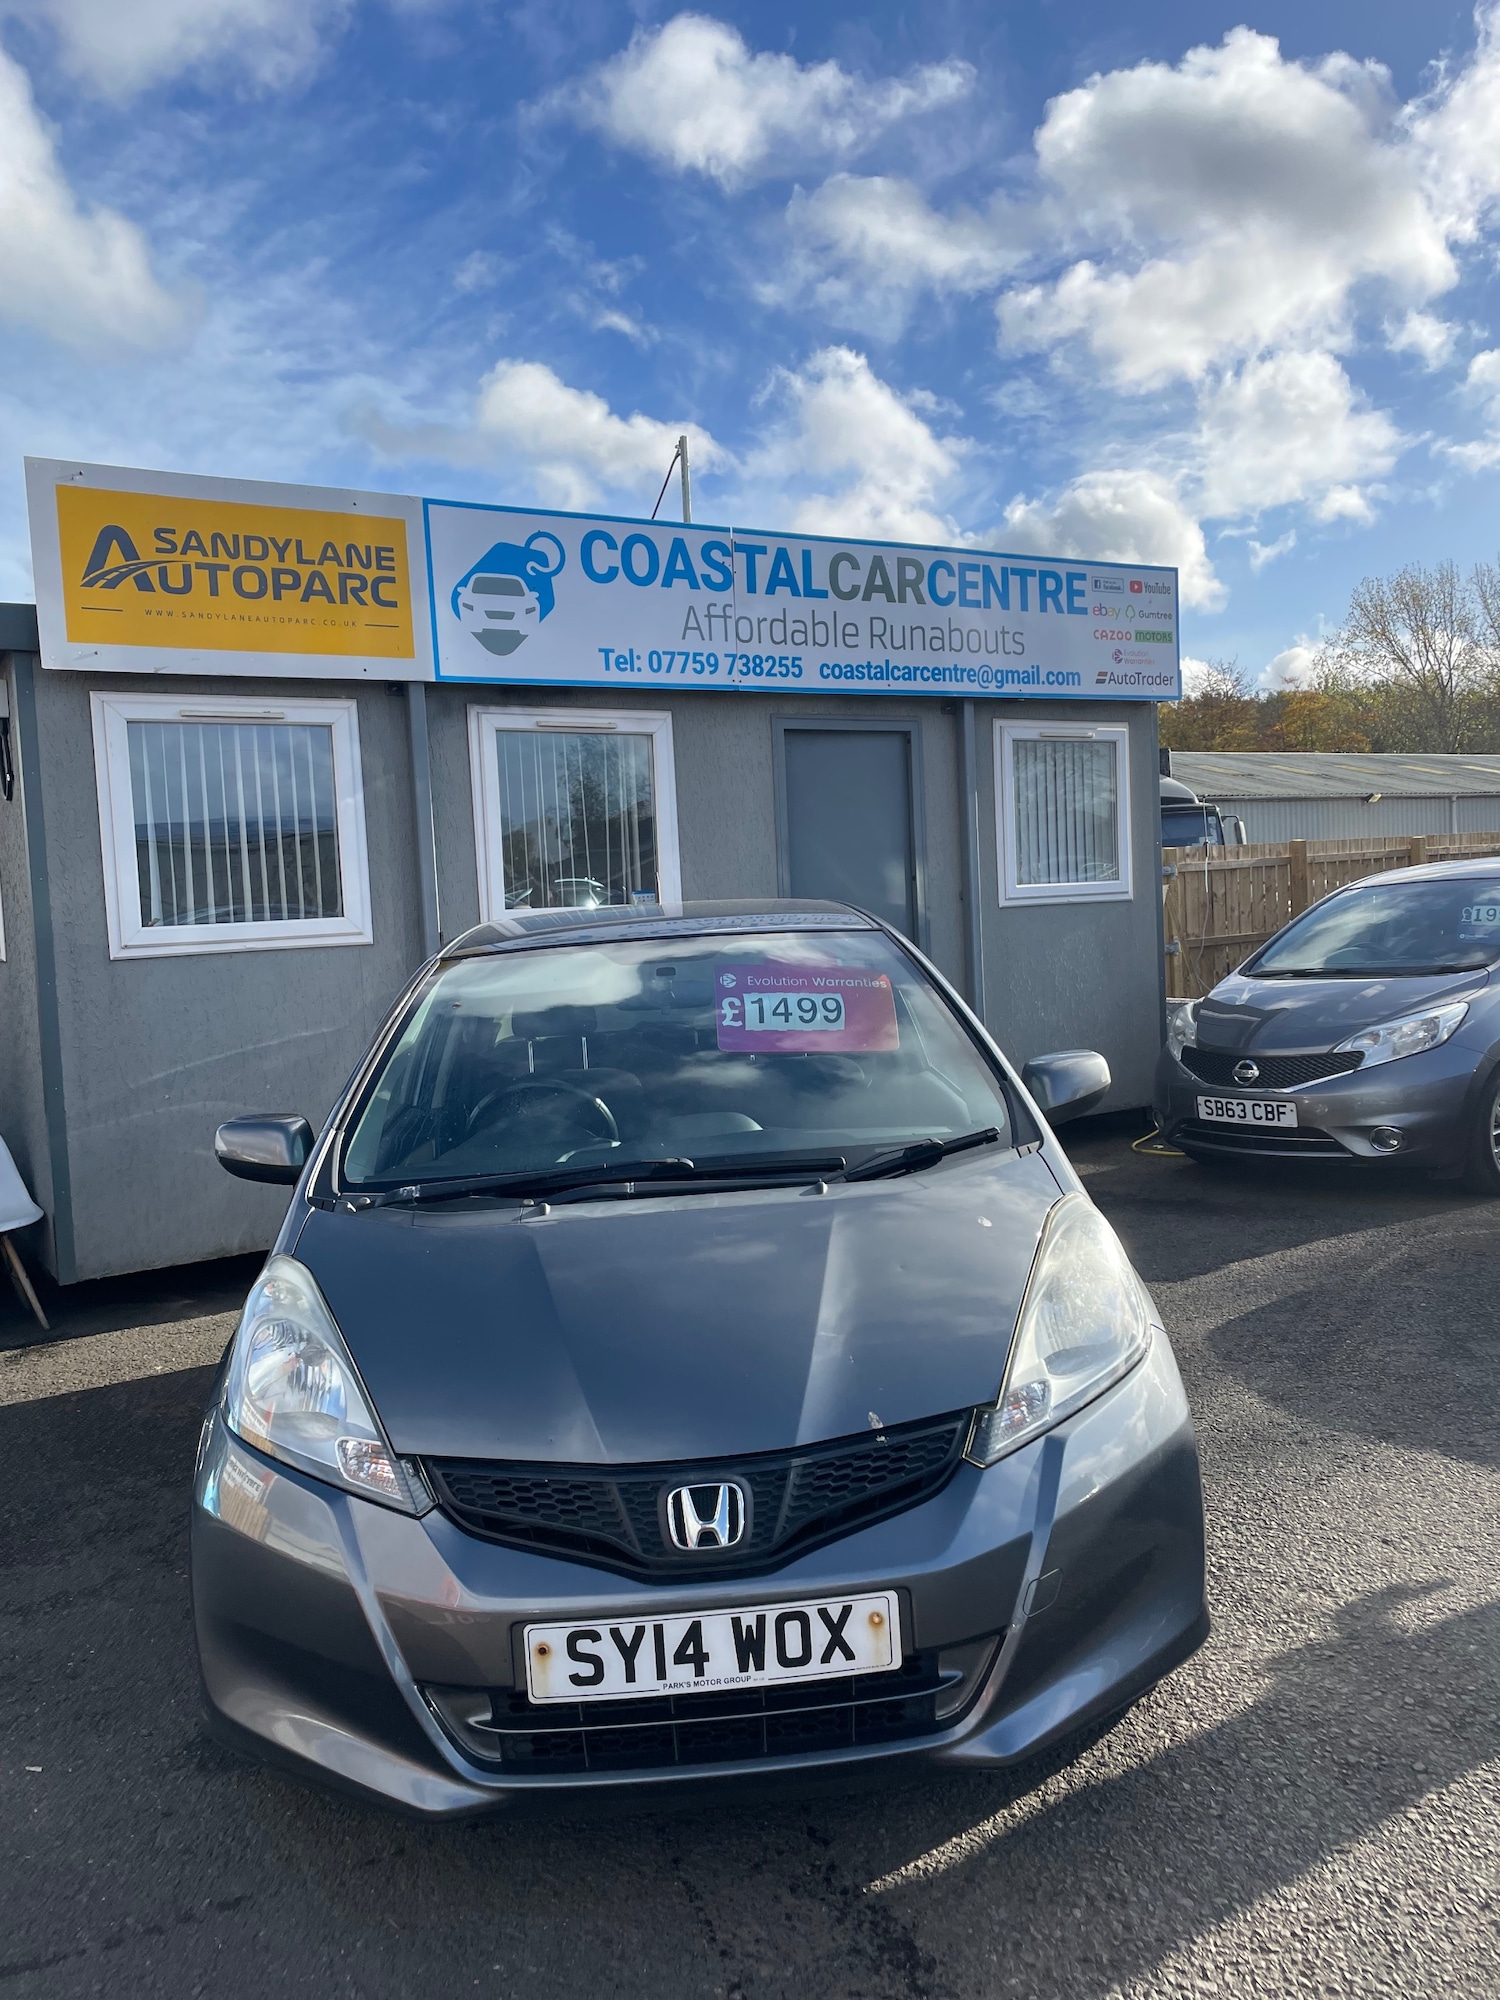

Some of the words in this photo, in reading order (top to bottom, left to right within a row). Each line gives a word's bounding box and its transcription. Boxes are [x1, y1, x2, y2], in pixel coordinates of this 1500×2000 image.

[154, 527, 395, 572] SANDYLANE
[80, 525, 398, 608] AUTOPARC
[580, 529, 1088, 615] COASTALCARCENTRE
[1144, 582, 1171, 595] YouTube
[144, 608, 357, 627] WWW.SANDYLANEAUTOPARC.CO.UK
[1093, 603, 1120, 620] ebay
[1138, 610, 1172, 620] Gumtree
[681, 603, 859, 648] Affordable
[869, 616, 1025, 656] Runabouts
[1093, 629, 1132, 641] CAZOO
[598, 648, 642, 673] Tel:
[648, 650, 719, 675] 07759
[724, 653, 803, 679] 738255
[819, 659, 1081, 689] coastalcarcentre@gmail.com
[1108, 671, 1174, 686] AutoTrader
[1461, 906, 1500, 922] £19
[747, 975, 808, 987] Evolution
[812, 976, 887, 989] Warranties
[721, 996, 842, 1027] £1499
[1204, 1099, 1247, 1119] SB63
[1252, 1103, 1287, 1121] CBF
[566, 1620, 710, 1687] SY14
[731, 1604, 856, 1673] WOX
[662, 1681, 692, 1690] PARK'S
[694, 1678, 722, 1687] MOTOR
[724, 1675, 752, 1685] GROUP
